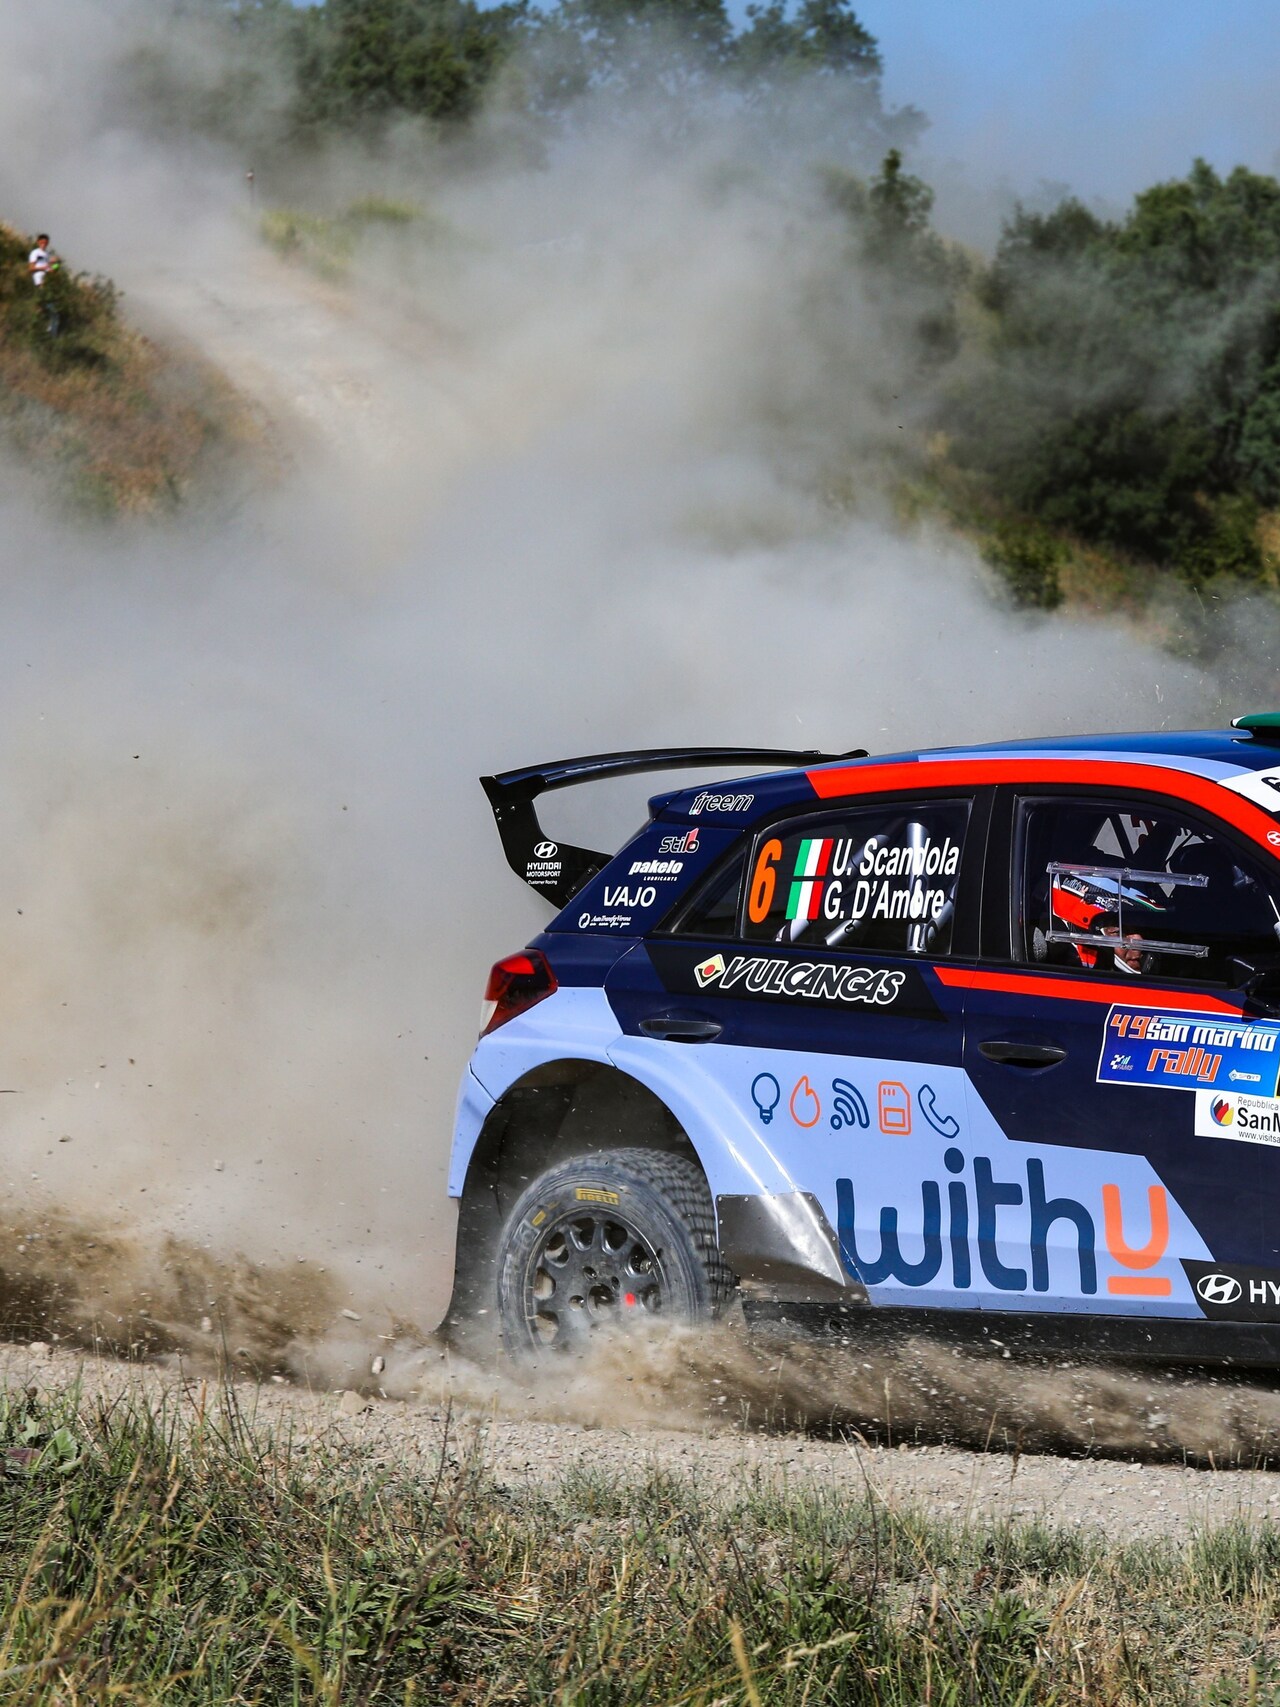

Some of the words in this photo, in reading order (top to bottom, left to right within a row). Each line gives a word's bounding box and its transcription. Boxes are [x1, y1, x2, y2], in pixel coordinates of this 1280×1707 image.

[689, 791, 754, 815] freem
[659, 828, 699, 853] Stilo
[526, 862, 562, 870] HYUNDAI
[628, 859, 684, 875] pakelo
[832, 838, 852, 876] U.
[859, 837, 960, 876] Scandola
[749, 838, 783, 924] 6
[603, 886, 656, 907] VAJO
[823, 880, 845, 919] G.
[851, 880, 945, 919] D'Amore
[719, 955, 907, 1004] VULCANGAS
[1146, 1021, 1188, 1043] san
[1192, 1026, 1278, 1052] marino
[1146, 1047, 1223, 1083] rally
[1238, 1096, 1279, 1111] Repubblica
[575, 1187, 619, 1205] PIRELLI
